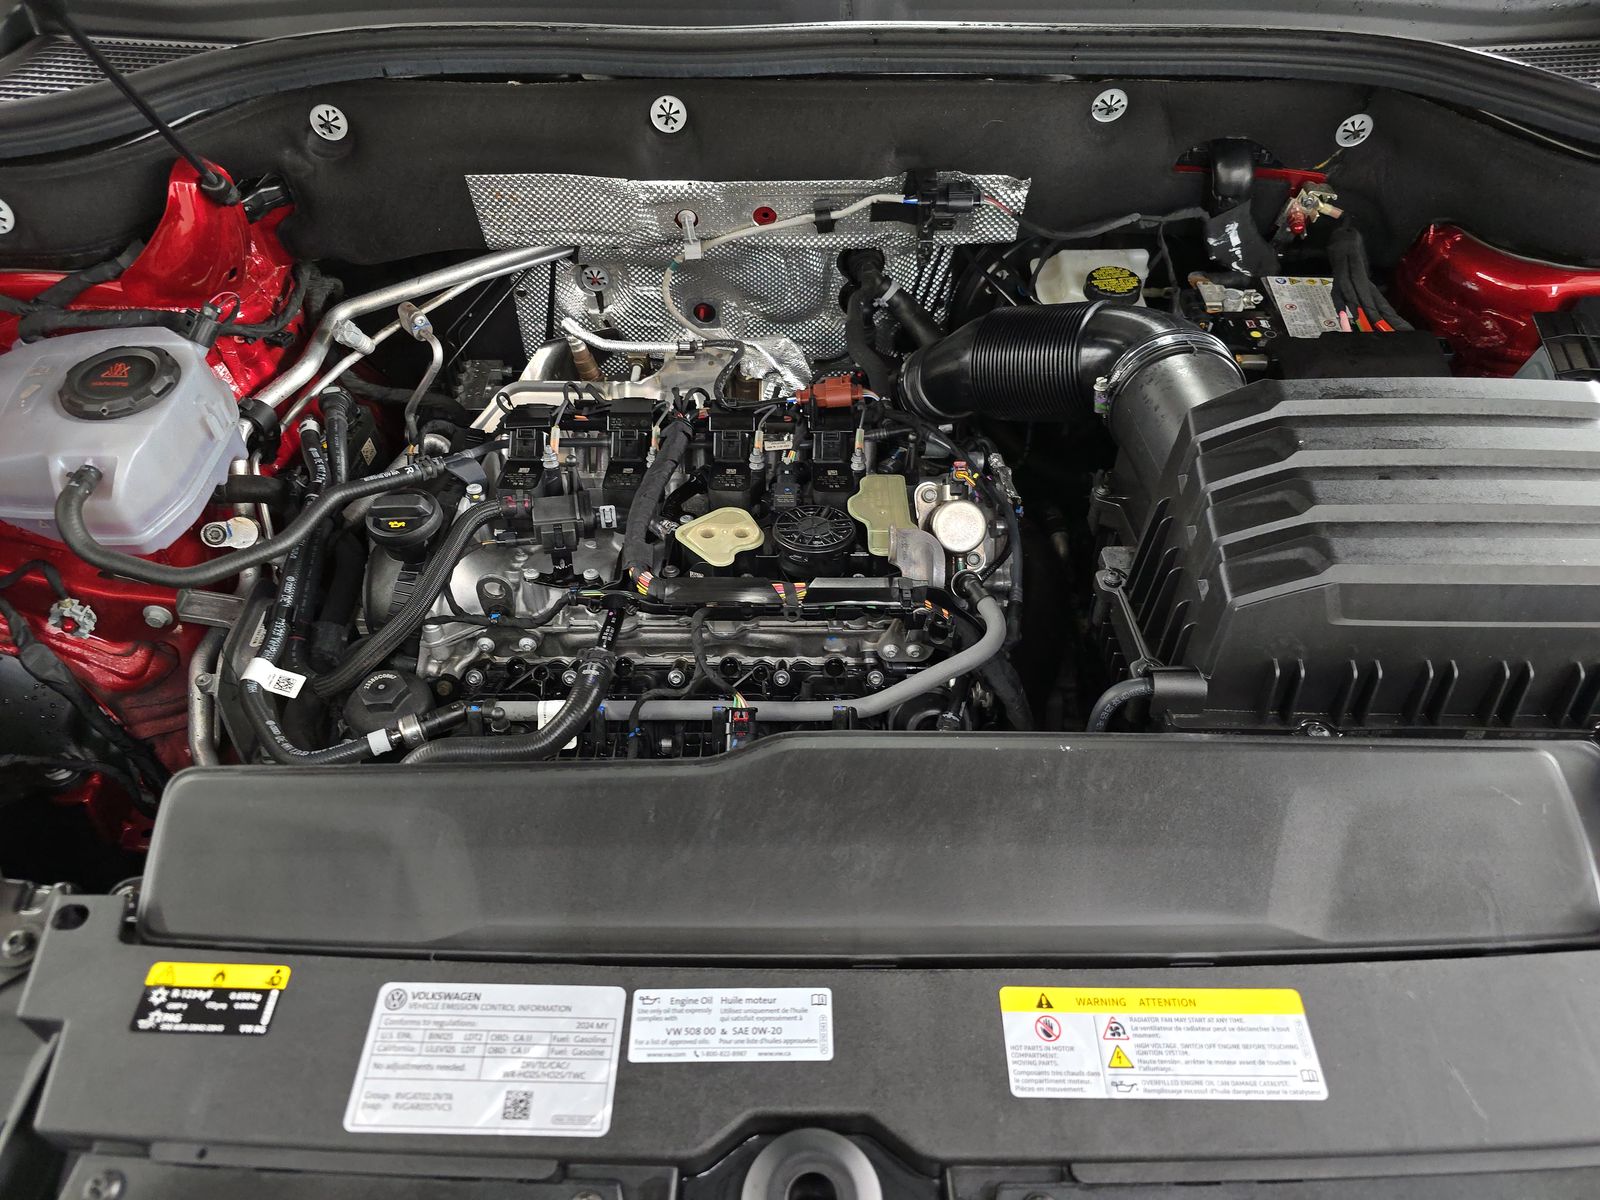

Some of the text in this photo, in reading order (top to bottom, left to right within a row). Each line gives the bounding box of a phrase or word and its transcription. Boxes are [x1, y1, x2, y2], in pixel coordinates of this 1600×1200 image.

[411, 991, 482, 1001] VOLKSWAGEN
[670, 996, 777, 1007] Engine Oil Huile moteur
[1075, 997, 1197, 1008] WARNING ATTENTION
[408, 1003, 440, 1011] VEHICLE
[441, 1003, 479, 1011] EMISSION
[480, 1003, 516, 1012] CONTROL
[743, 1008, 780, 1016] uniquement
[384, 1018, 421, 1027] Conforms
[422, 1019, 431, 1027] to
[576, 1021, 594, 1030] 2024
[595, 1022, 608, 1030] MY
[665, 1027, 682, 1036] VW
[684, 1027, 701, 1036] 508
[703, 1027, 716, 1036] 00
[732, 1027, 750, 1035] SAE
[751, 1027, 783, 1035] 0W-20
[552, 1035, 569, 1044] Fuel:
[573, 1035, 607, 1045] Gasoline
[668, 1039, 698, 1047] approved
[550, 1048, 568, 1057] Fuel:
[571, 1048, 605, 1057] Gasoline
[374, 1062, 385, 1071] No
[386, 1062, 435, 1073] adjustments
[1012, 1069, 1051, 1077] Composants
